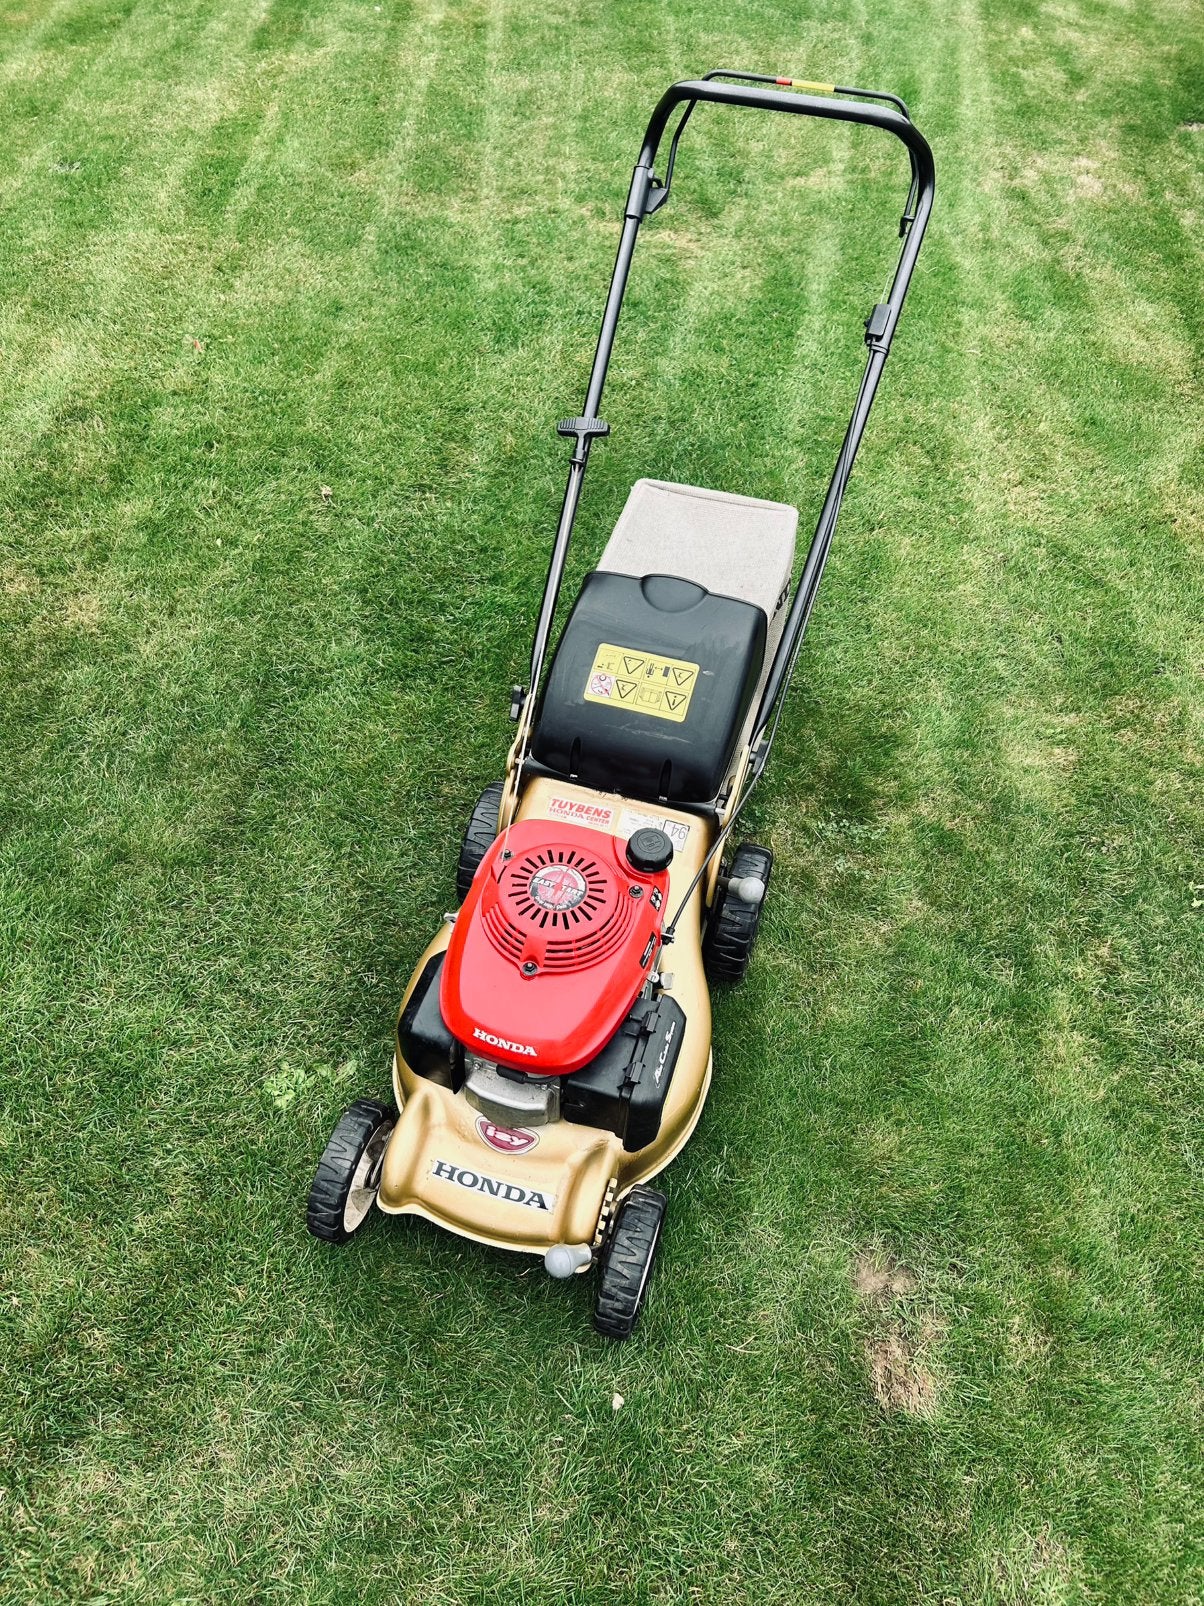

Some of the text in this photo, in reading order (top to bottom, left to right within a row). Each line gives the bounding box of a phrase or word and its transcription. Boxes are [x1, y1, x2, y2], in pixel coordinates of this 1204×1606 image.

[549, 806, 585, 819] HONDA
[586, 815, 610, 825] CENTER
[550, 798, 612, 819] TUYBENS
[671, 824, 687, 840] 94
[532, 876, 555, 888] EASY
[472, 1027, 538, 1057] HONDA
[432, 1160, 549, 1211] HONDA
